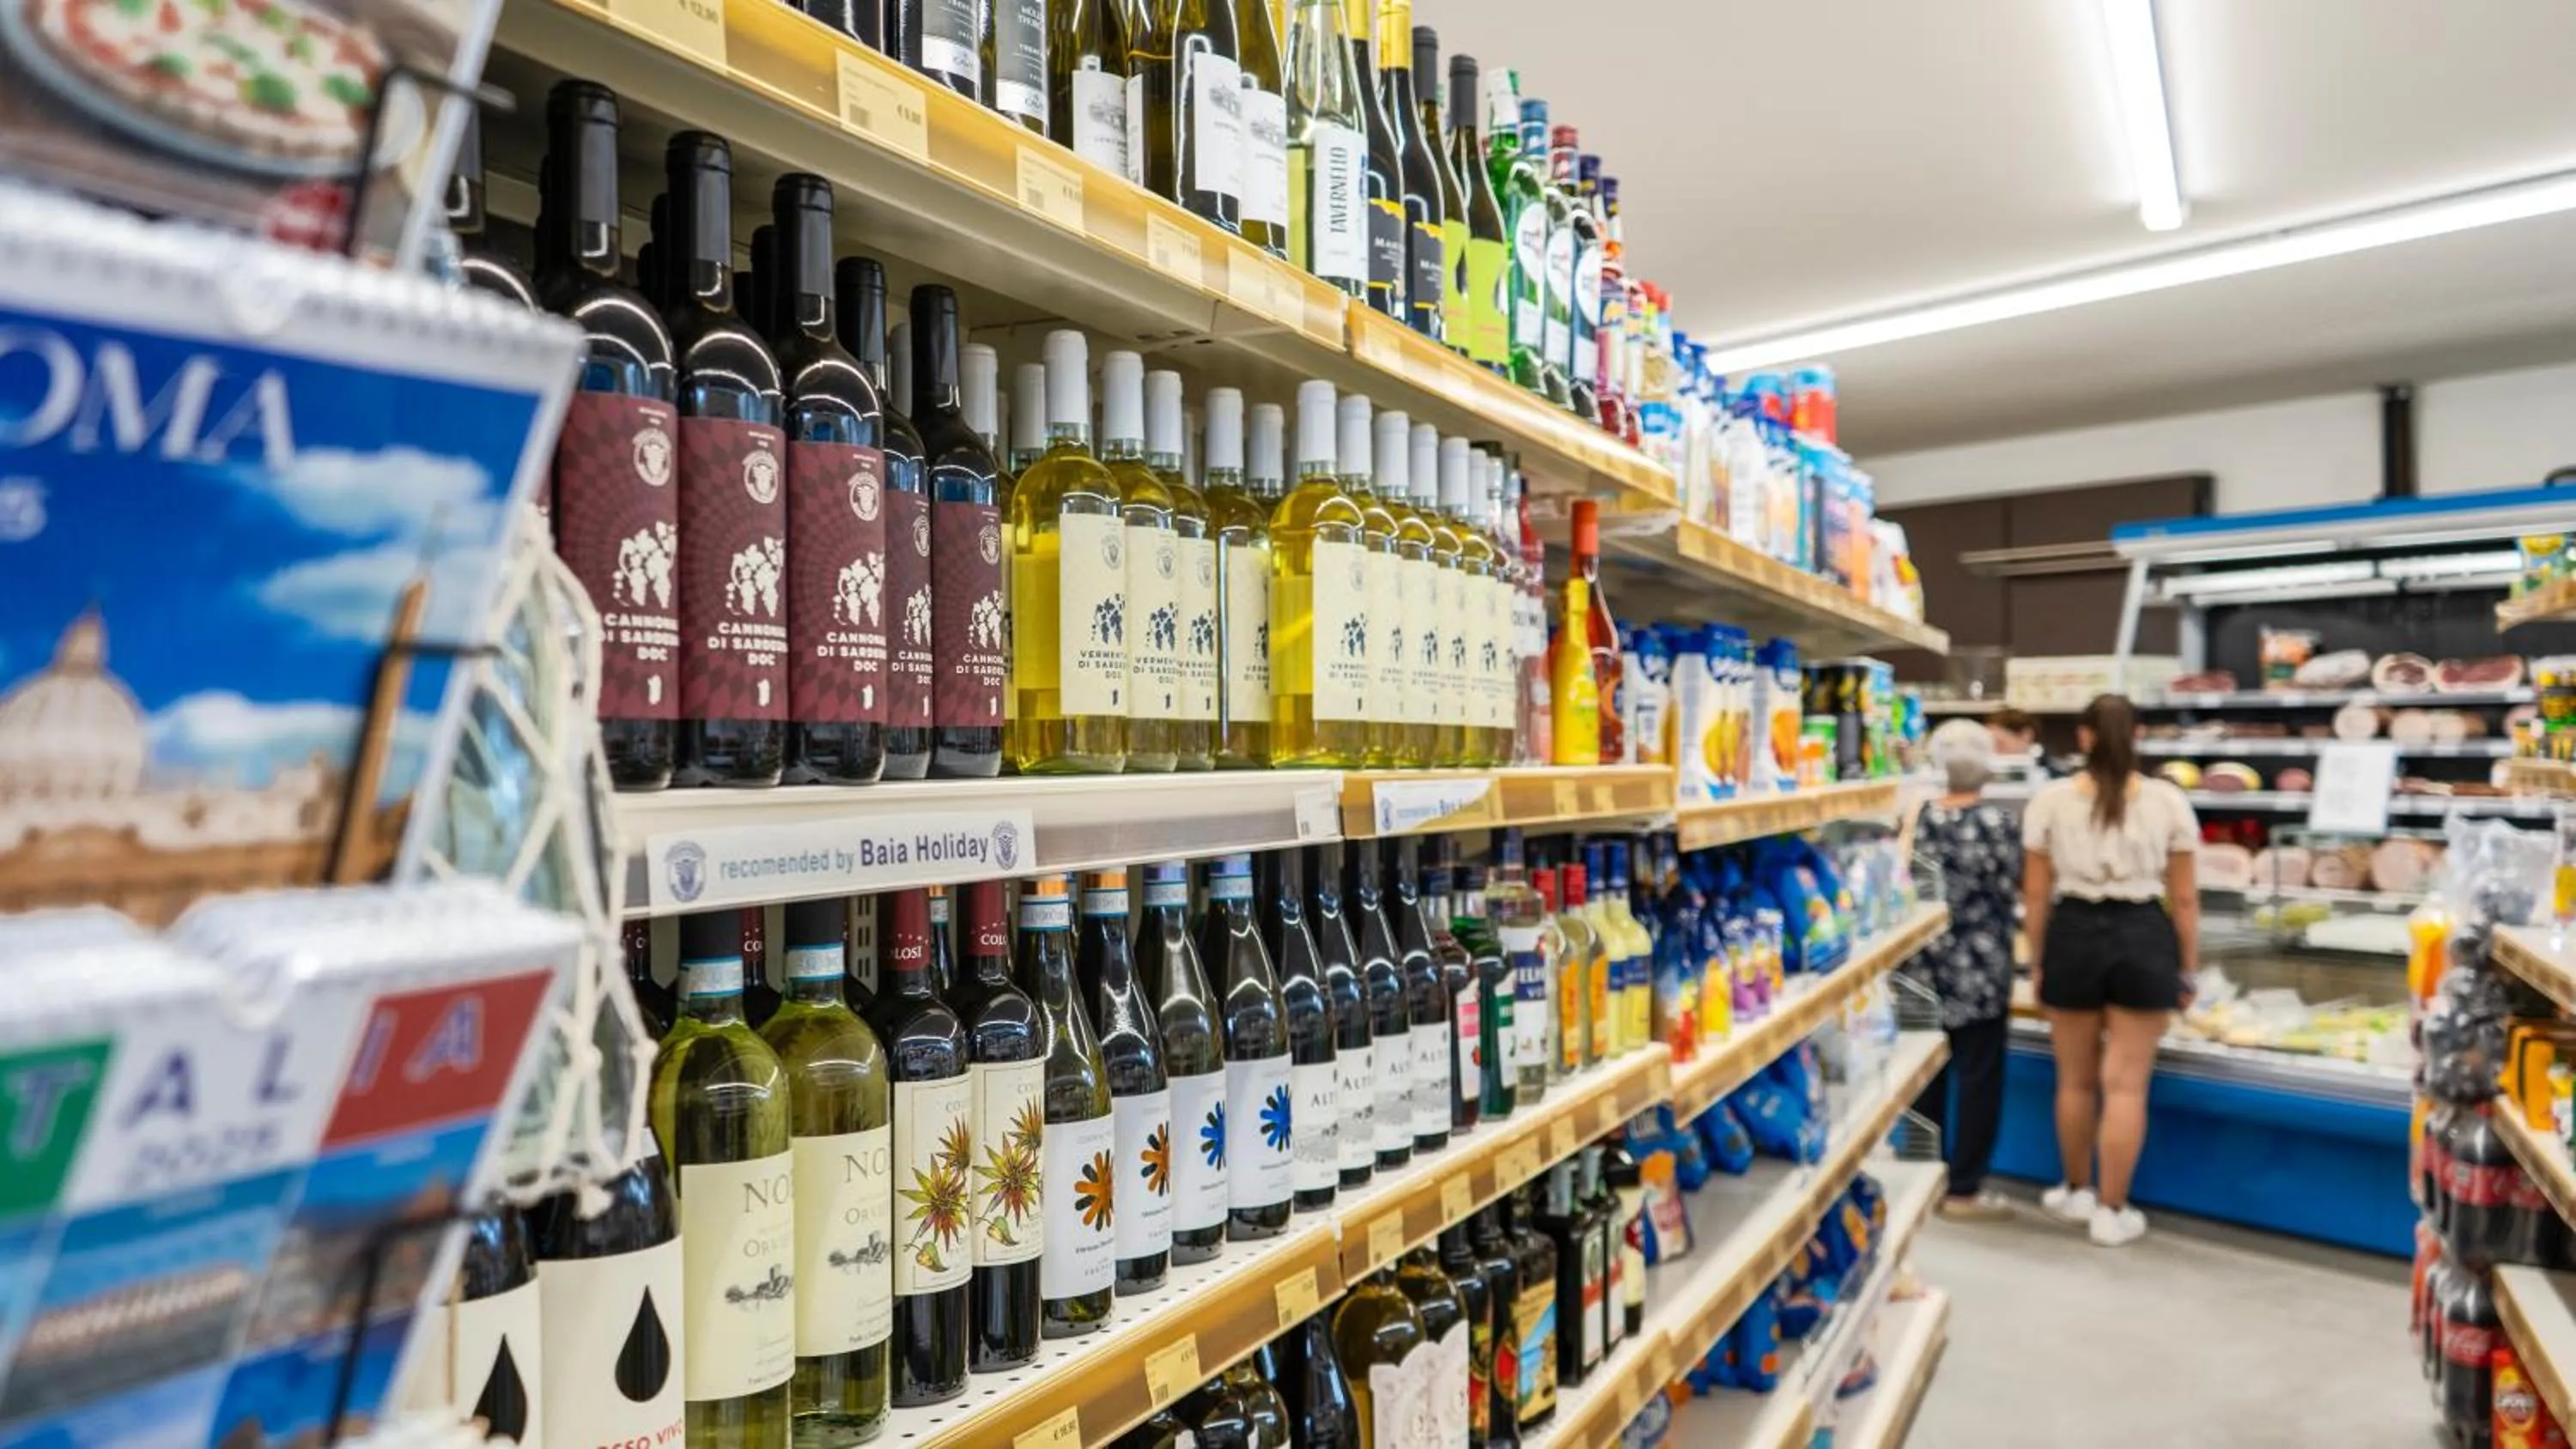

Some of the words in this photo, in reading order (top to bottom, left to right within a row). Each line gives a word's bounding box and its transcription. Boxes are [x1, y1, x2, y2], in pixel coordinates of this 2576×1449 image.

[1329, 147, 1348, 233] TAVERNELLO
[707, 636, 726, 649] DI
[637, 646, 668, 661] DOC
[748, 652, 775, 665] DOC
[817, 646, 834, 657] DI
[854, 660, 878, 672] DOC
[891, 663, 904, 672] DI
[956, 666, 969, 675] DI
[1078, 660, 1090, 669] DI
[1133, 665, 1145, 674] DI
[983, 677, 1000, 686] DOC
[647, 675, 662, 705] 1
[757, 678, 771, 707] 1
[862, 684, 874, 711] 1
[1112, 689, 1119, 706] 1
[923, 695, 930, 717] 1
[990, 695, 997, 717] 1
[1165, 693, 1171, 710] 1
[720, 849, 829, 880] recomended
[835, 848, 855, 874] by
[860, 838, 908, 867] Baia
[915, 832, 988, 864] Holiday
[882, 945, 922, 961] LOSI
